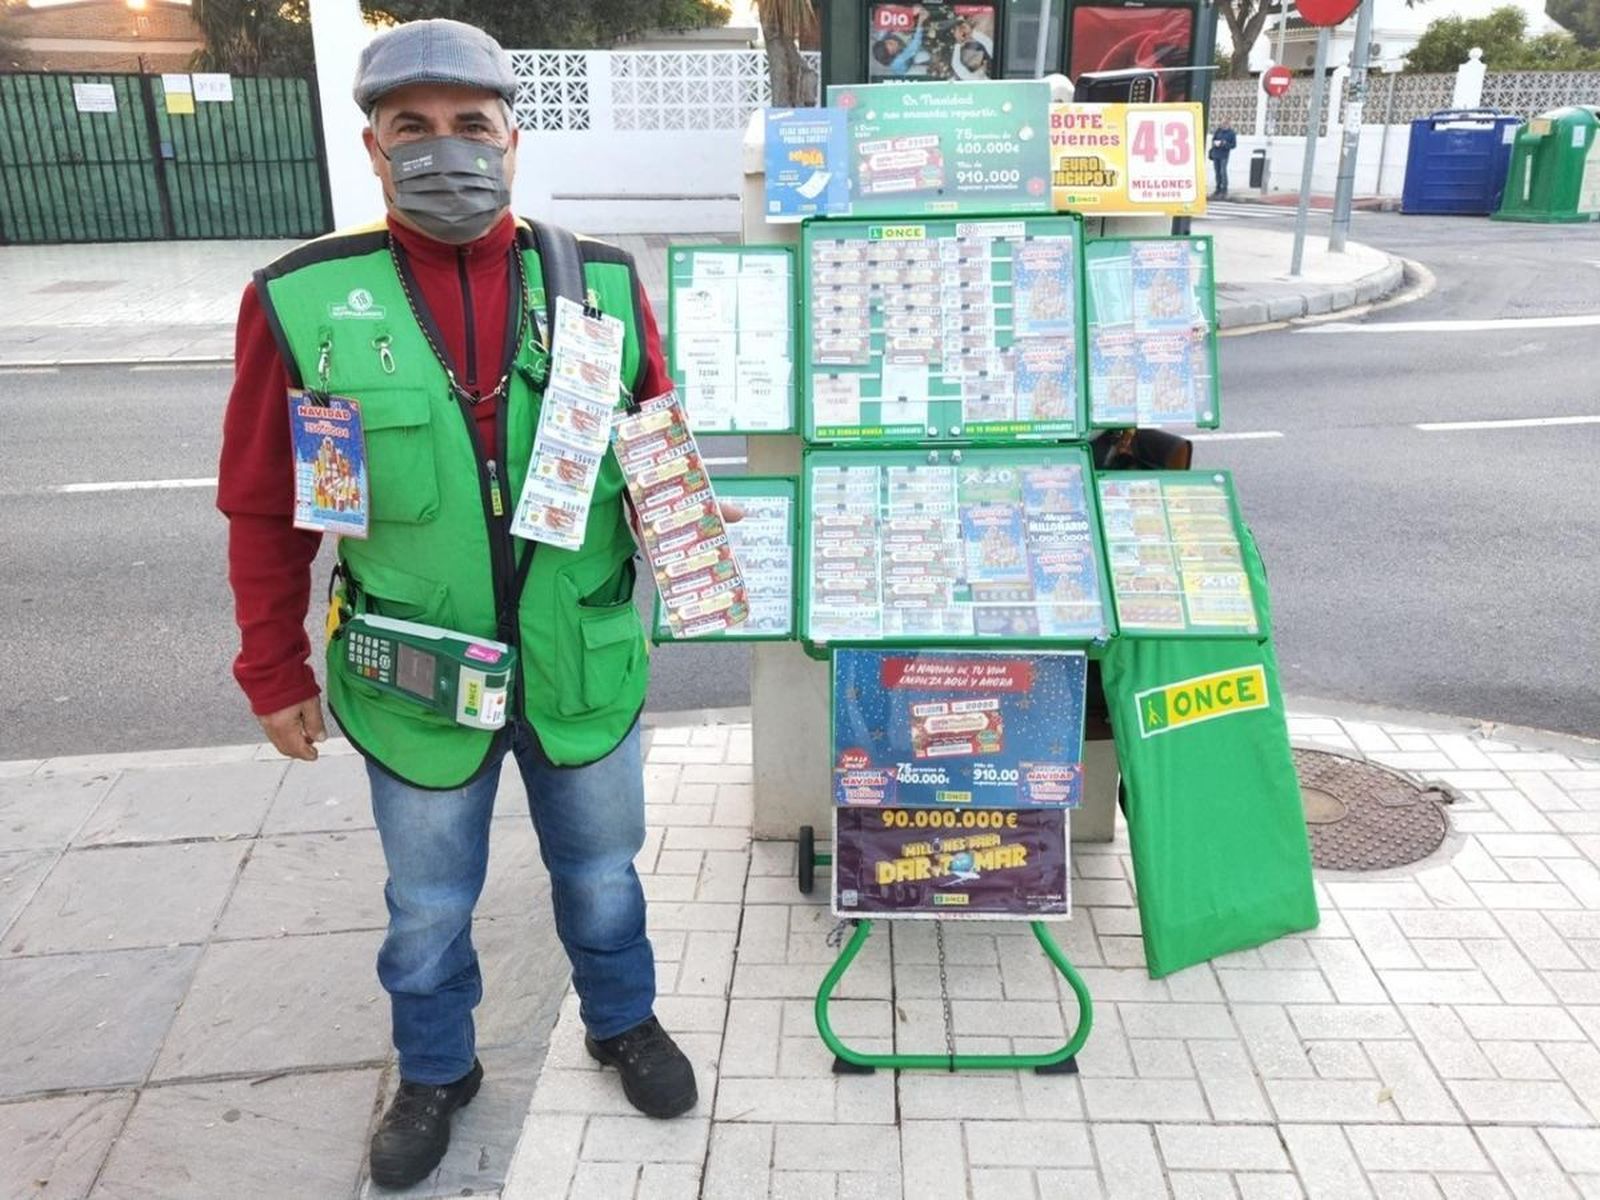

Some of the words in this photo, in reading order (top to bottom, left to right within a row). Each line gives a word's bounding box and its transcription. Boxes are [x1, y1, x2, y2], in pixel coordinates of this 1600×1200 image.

[1051, 114, 1103, 129] BOTE
[956, 128, 973, 140] 75
[1051, 132, 1120, 147] viernes
[1131, 120, 1191, 166] 43
[1060, 156, 1099, 172] EURO
[956, 170, 1020, 184] 910.000
[1132, 179, 1193, 189] MILLONES
[885, 228, 922, 237] ONCE
[300, 406, 350, 420] NAVIDAD
[467, 681, 478, 707] ONCE
[1173, 675, 1257, 717] ONCE
[896, 762, 913, 773] 75
[972, 769, 1019, 781] 910.00
[876, 856, 932, 886] DAR
